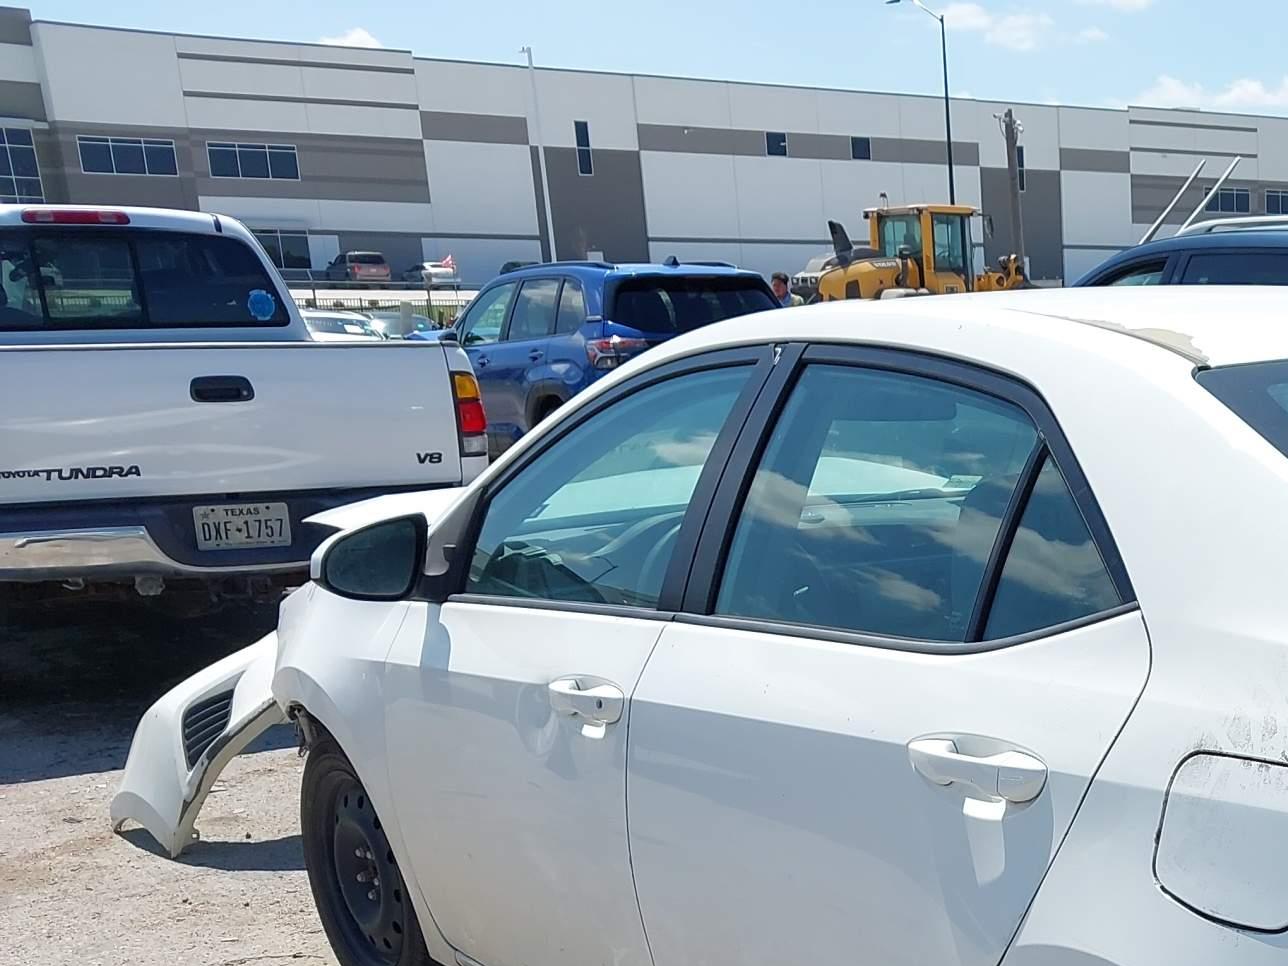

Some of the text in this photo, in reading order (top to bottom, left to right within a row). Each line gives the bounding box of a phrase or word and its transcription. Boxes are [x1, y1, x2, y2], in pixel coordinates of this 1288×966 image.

[416, 452, 443, 464] V8
[40, 465, 142, 481] TUNDRA
[223, 507, 260, 517] TEXAS
